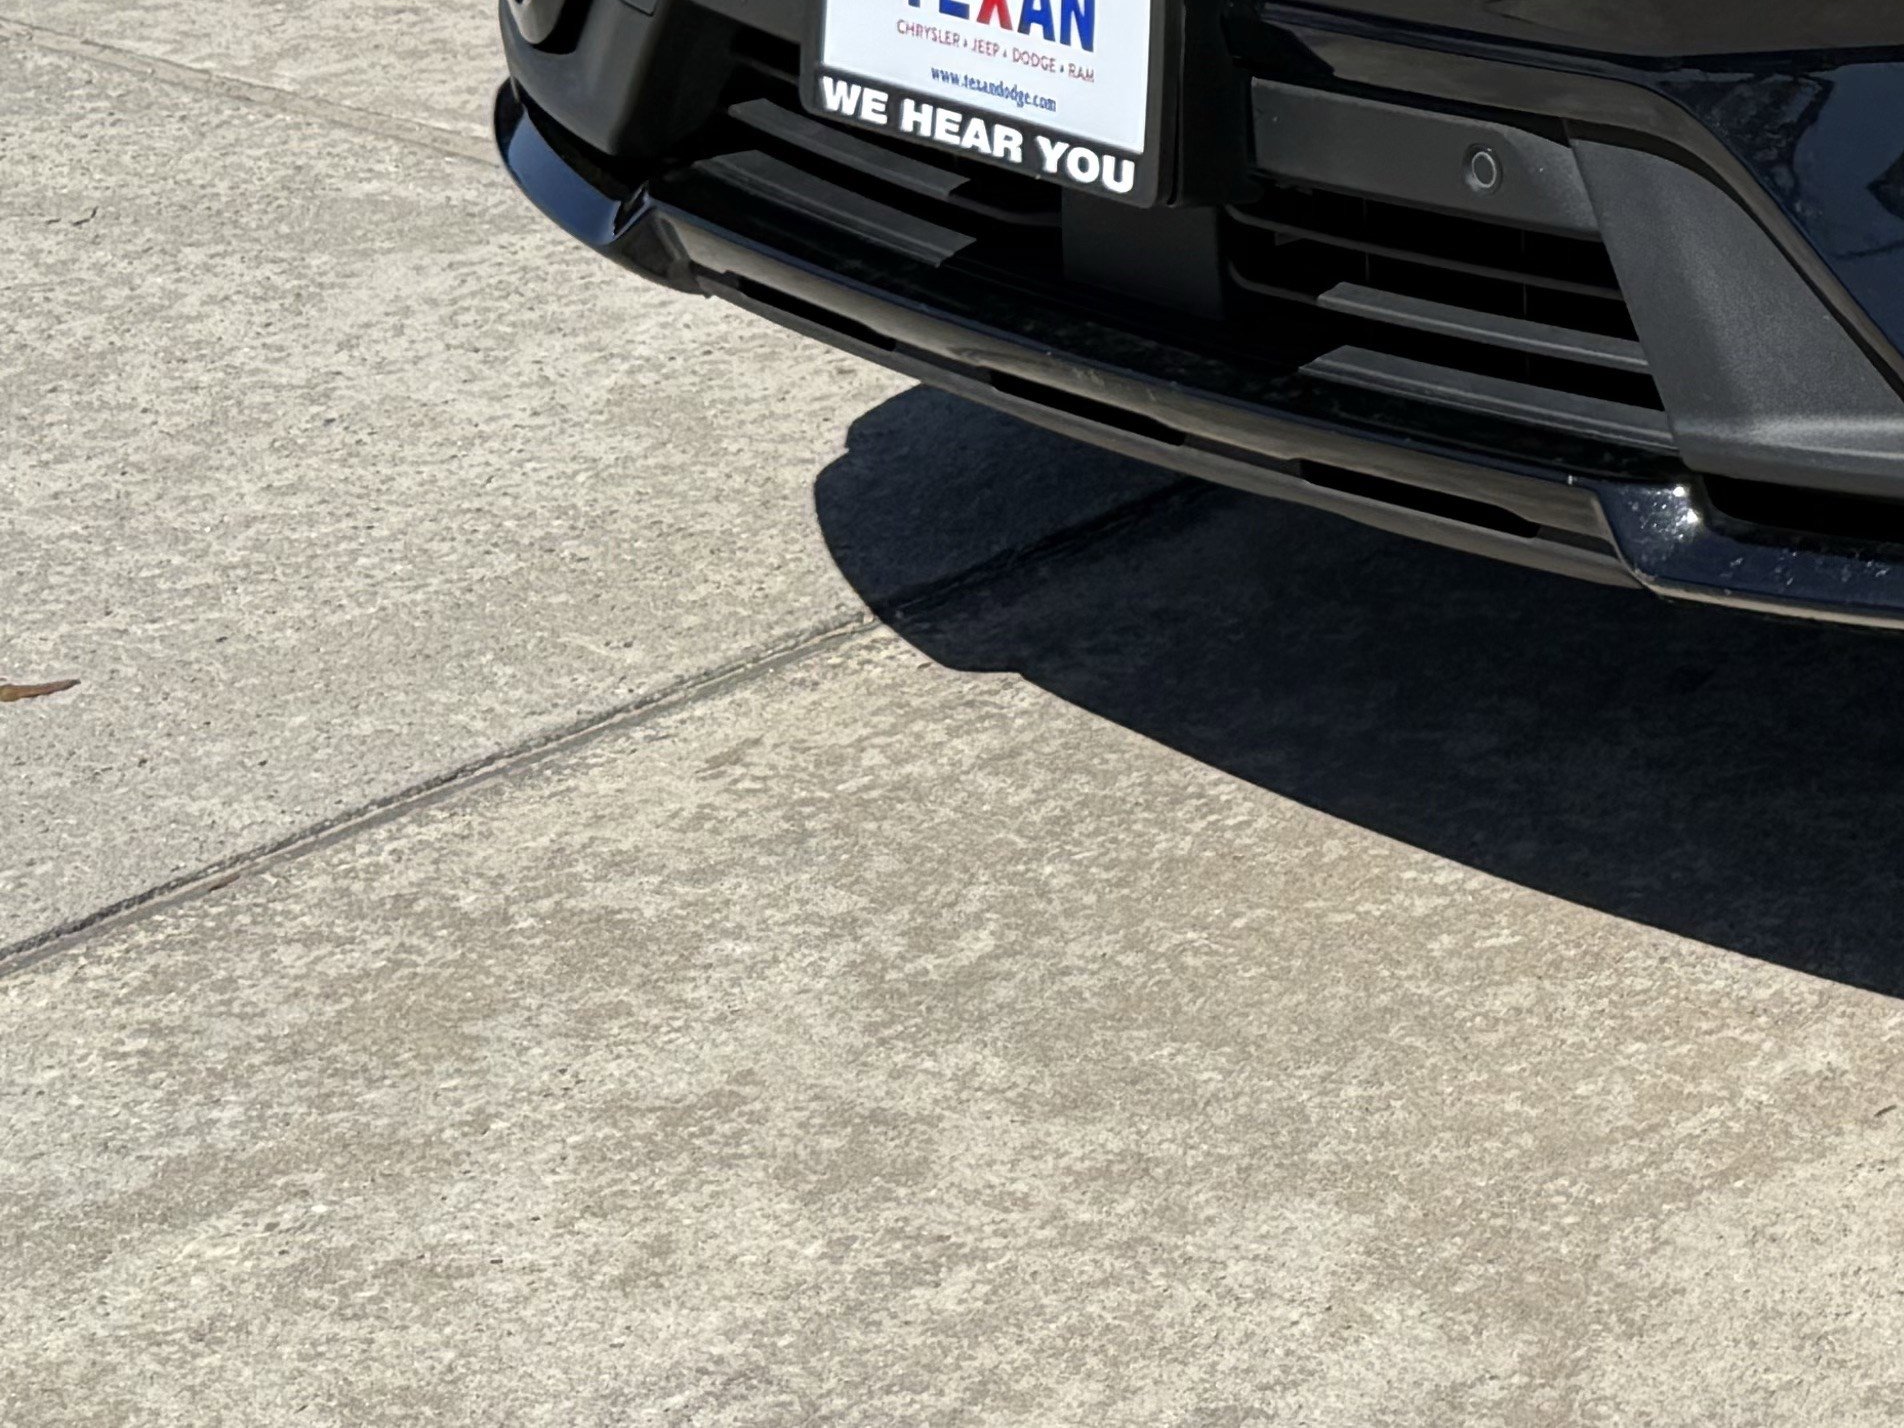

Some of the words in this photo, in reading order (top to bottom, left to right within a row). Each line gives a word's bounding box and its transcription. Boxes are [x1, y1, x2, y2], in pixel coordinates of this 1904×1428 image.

[896, 19, 960, 48] CHRYSLER
[971, 37, 1000, 58] JEEP
[1012, 47, 1056, 73] DODGE
[1067, 62, 1096, 83] RAM
[931, 66, 1057, 113] www.texandodge.com
[820, 75, 889, 126] WE
[900, 97, 1023, 163] HEAR
[1036, 135, 1135, 194] YOU
